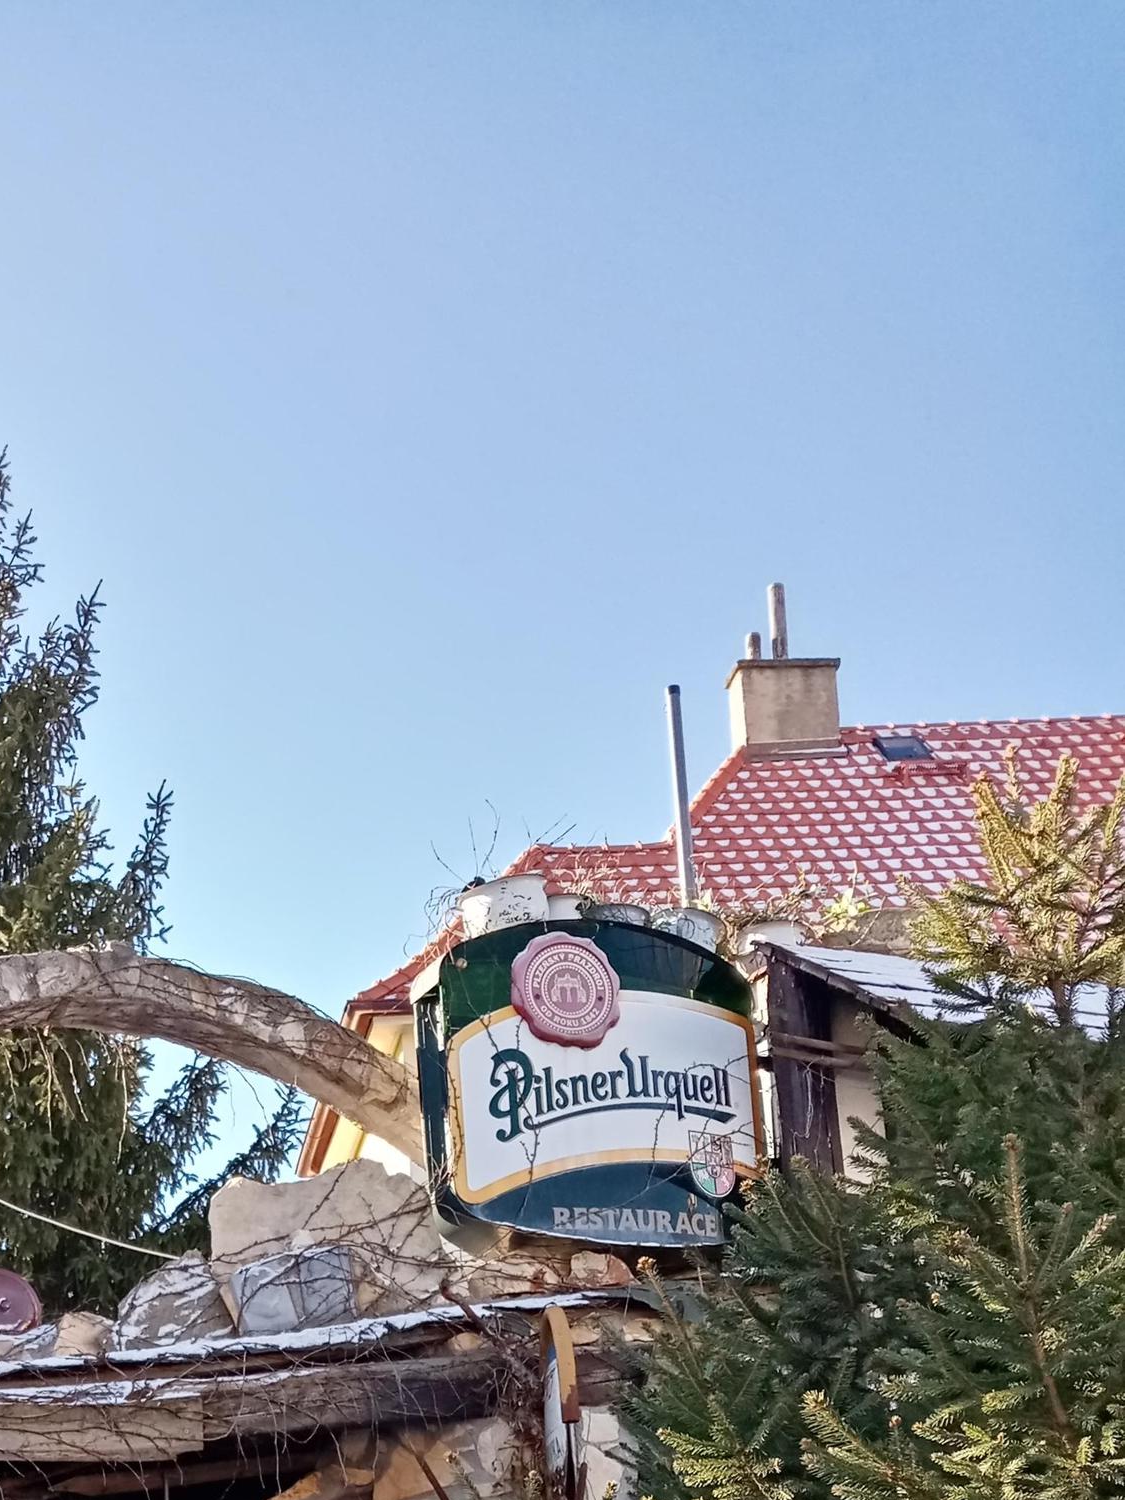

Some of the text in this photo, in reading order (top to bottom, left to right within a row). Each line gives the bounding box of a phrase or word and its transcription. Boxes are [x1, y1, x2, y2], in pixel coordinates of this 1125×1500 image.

[568, 953, 605, 991] PRAZDROJ
[541, 1005, 600, 1027] OD ROKU 1842
[489, 1047, 733, 1143] Pilsner Urquell
[553, 1206, 719, 1238] RESTAURACE
